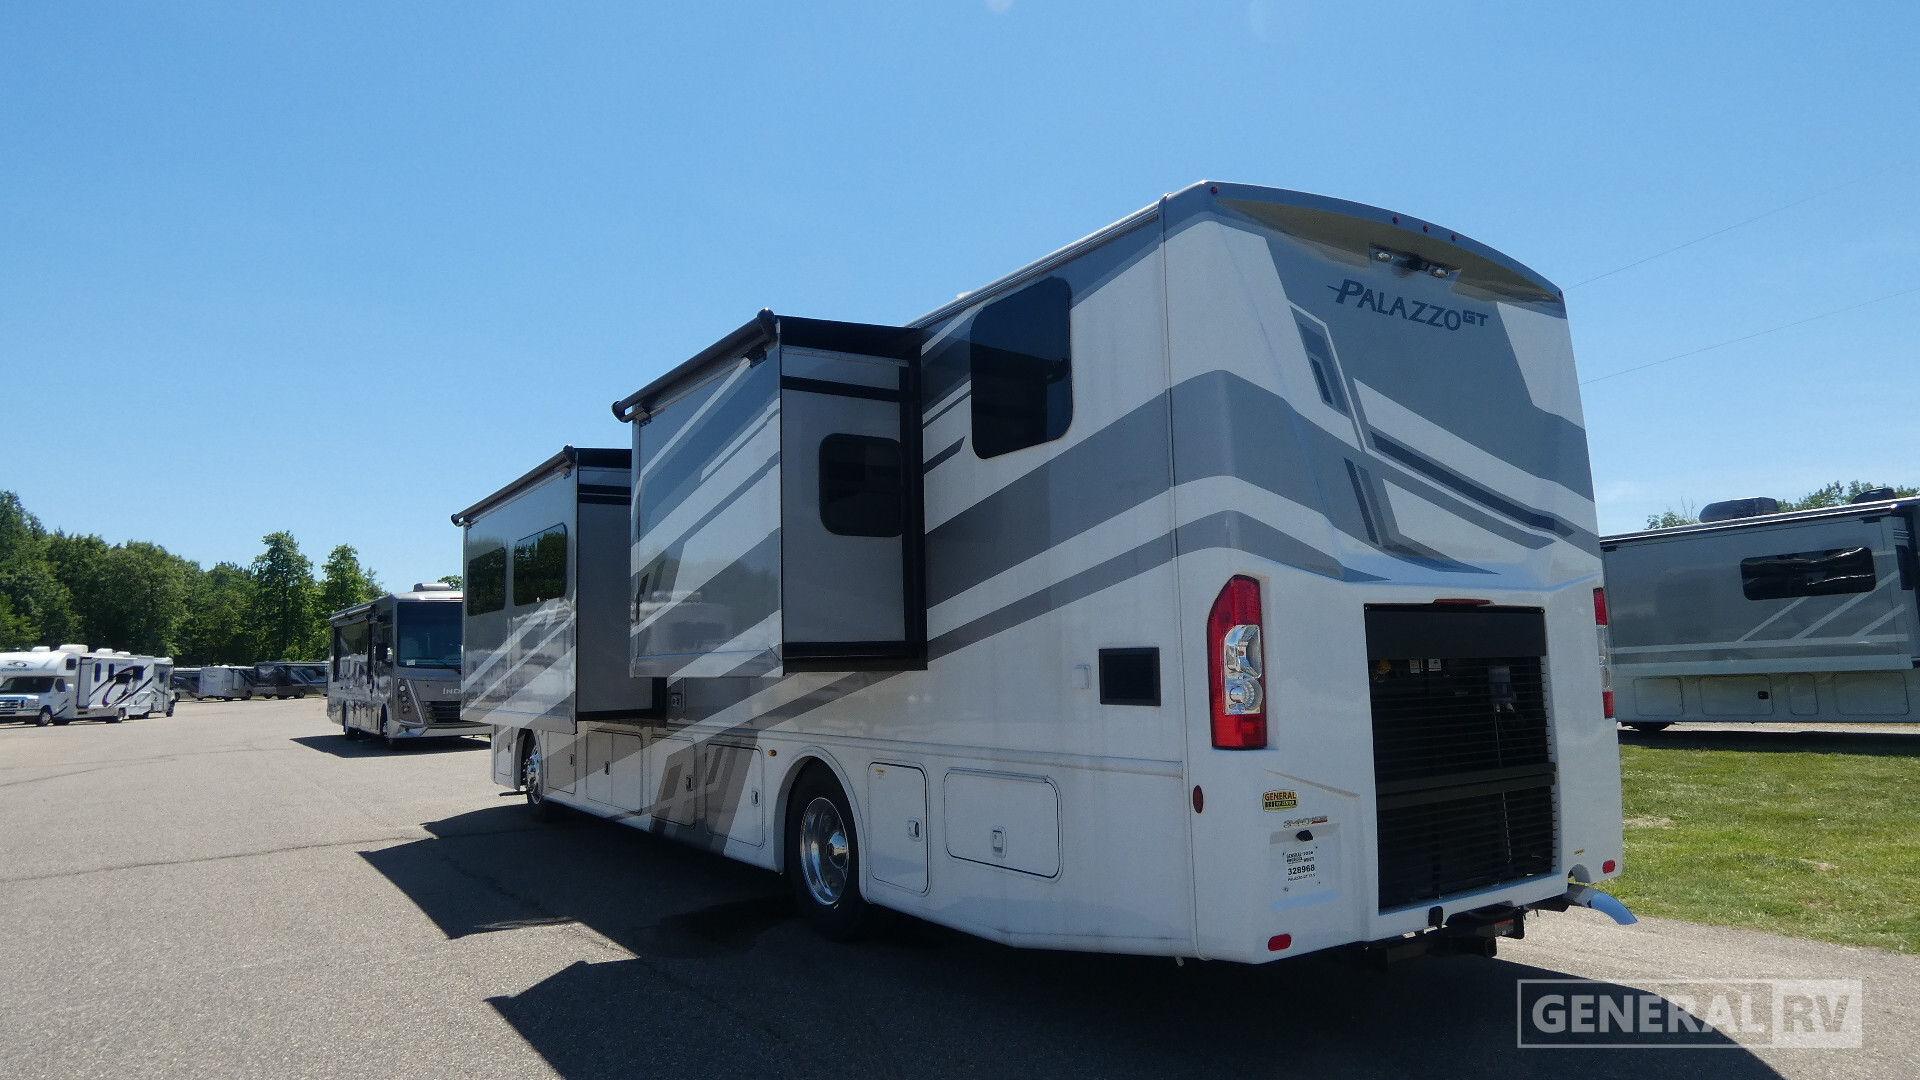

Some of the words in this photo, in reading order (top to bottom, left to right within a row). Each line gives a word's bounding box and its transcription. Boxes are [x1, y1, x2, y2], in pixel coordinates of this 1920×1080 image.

[1328, 278, 1461, 331] PALAZZO
[1462, 309, 1489, 326] GT
[1265, 792, 1297, 801] GENERAL
[1287, 864, 1316, 876] 328968
